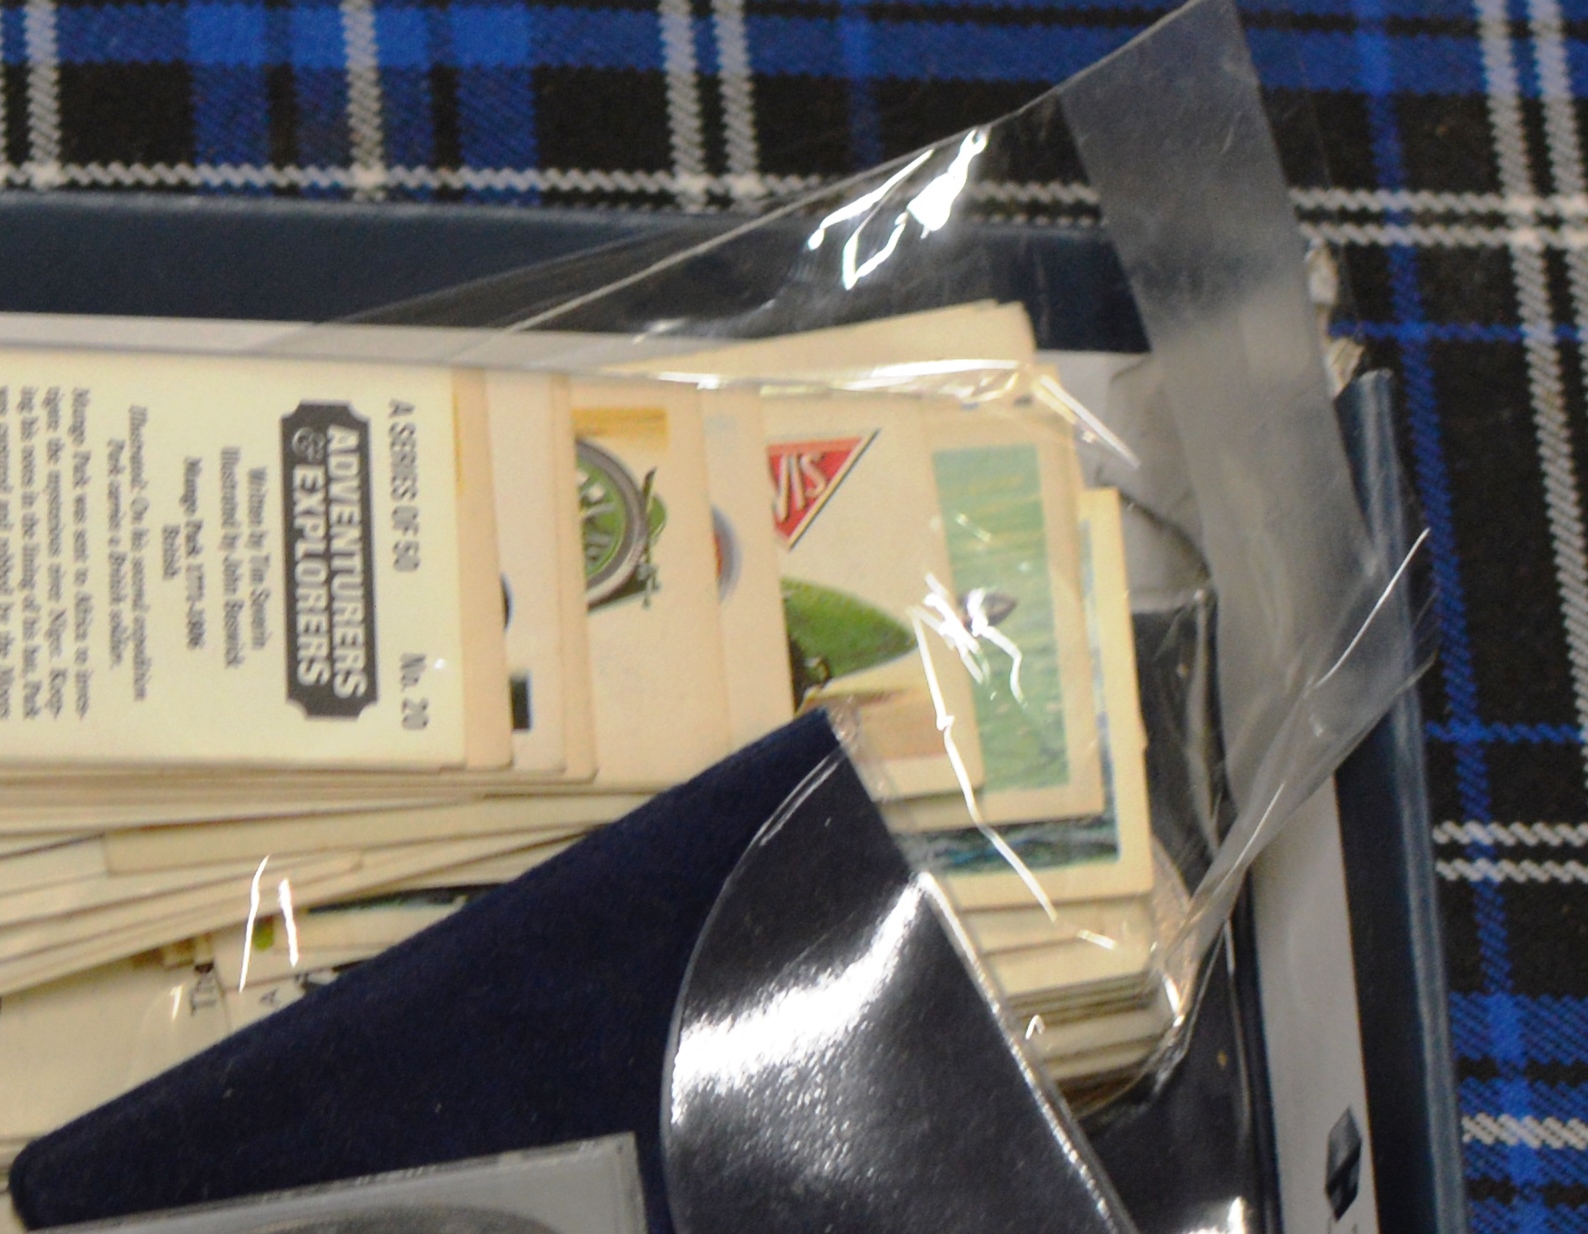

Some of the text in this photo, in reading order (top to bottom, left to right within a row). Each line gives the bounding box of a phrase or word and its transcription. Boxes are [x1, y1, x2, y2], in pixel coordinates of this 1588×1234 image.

[67, 387, 89, 446] Mungo
[73, 450, 90, 488] Park
[106, 439, 125, 476] Park
[179, 456, 202, 514] Mungo
[219, 446, 242, 527] Illustrated
[246, 467, 268, 526] Written
[73, 494, 87, 523] was
[73, 529, 88, 563] sent
[161, 524, 181, 580] British
[184, 519, 204, 557] Park
[218, 533, 241, 549] by
[246, 530, 268, 546] by
[73, 569, 88, 585] to
[222, 554, 242, 595] John
[250, 554, 270, 584] Tim
[289, 464, 331, 687] EXPLORERS
[325, 425, 366, 698] ADVENTURERS
[388, 399, 429, 731] A SERIES OF 50 No. 20
[74, 646, 89, 665] to
